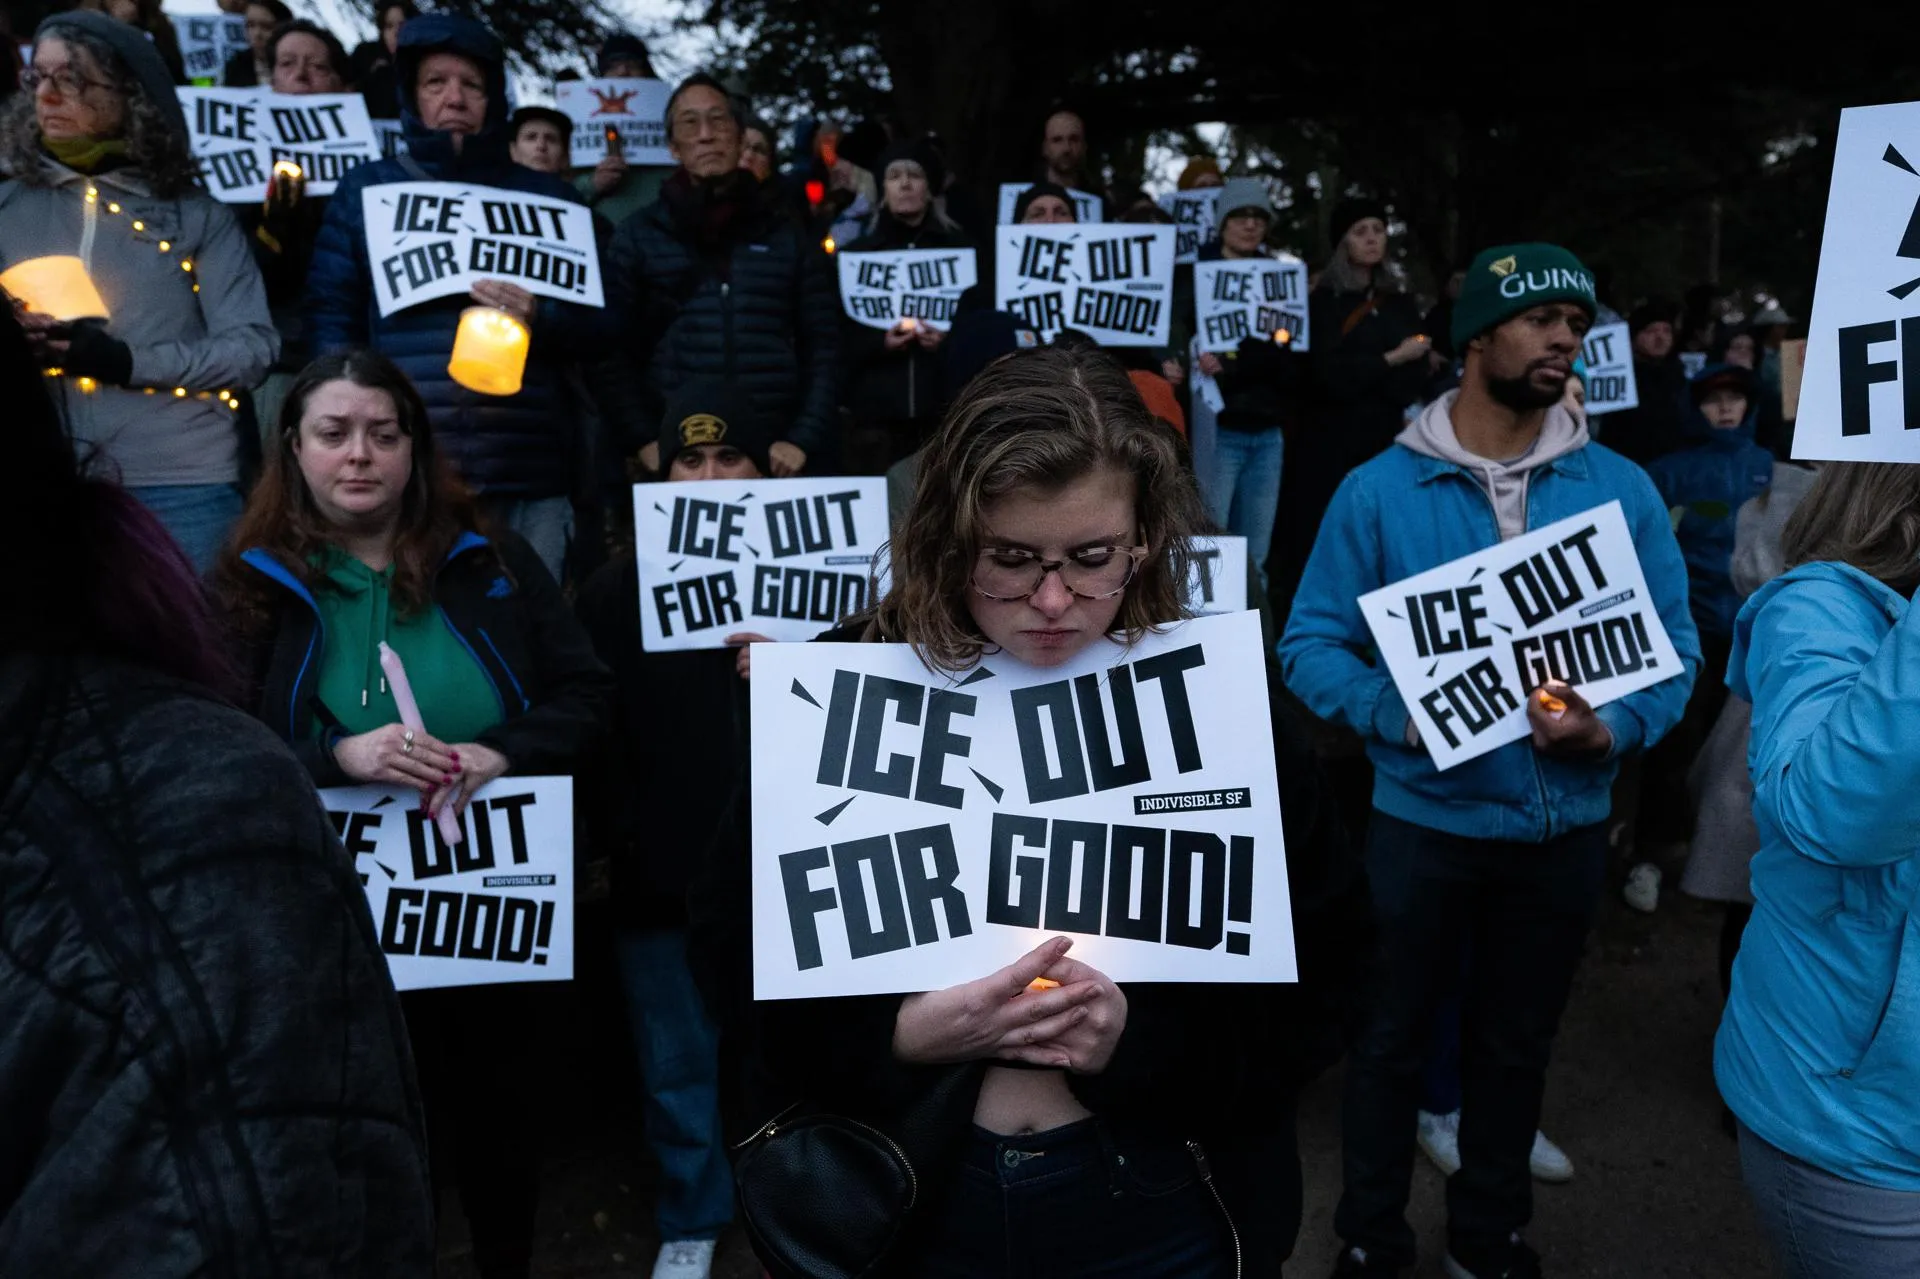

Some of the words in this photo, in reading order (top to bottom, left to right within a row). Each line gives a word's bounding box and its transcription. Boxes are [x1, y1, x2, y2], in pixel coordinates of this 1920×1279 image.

[196, 98, 256, 142] ICE
[269, 104, 347, 144] OUT
[394, 193, 465, 234] ICE
[482, 201, 567, 241] OUT
[382, 241, 460, 300] FOR
[469, 237, 587, 295] GOOD!
[857, 260, 898, 292] ICE
[907, 257, 960, 290] OUT
[1018, 235, 1074, 284] ICE
[1087, 235, 1156, 283] OUT
[1213, 270, 1254, 303] ICE
[1262, 270, 1299, 302] OUT
[849, 296, 895, 320] FOR
[1073, 287, 1162, 337] GOOD!
[1205, 309, 1252, 345] FOR
[668, 497, 746, 562] ICE
[764, 490, 861, 559] OUT
[652, 571, 743, 639] FOR
[1404, 584, 1493, 658] ICE
[1498, 523, 1608, 630] OUT
[1419, 656, 1520, 751] FOR
[1511, 611, 1658, 699] GOOD!
[816, 669, 977, 810] ICE
[1010, 643, 1206, 805] OUT
[1140, 793, 1223, 811] INDIVISIBLE
[1225, 791, 1243, 805] SF
[406, 792, 536, 881] OUT
[778, 823, 973, 971] FOR
[985, 812, 1254, 956] GOOD!
[381, 887, 556, 967] GOOD!
